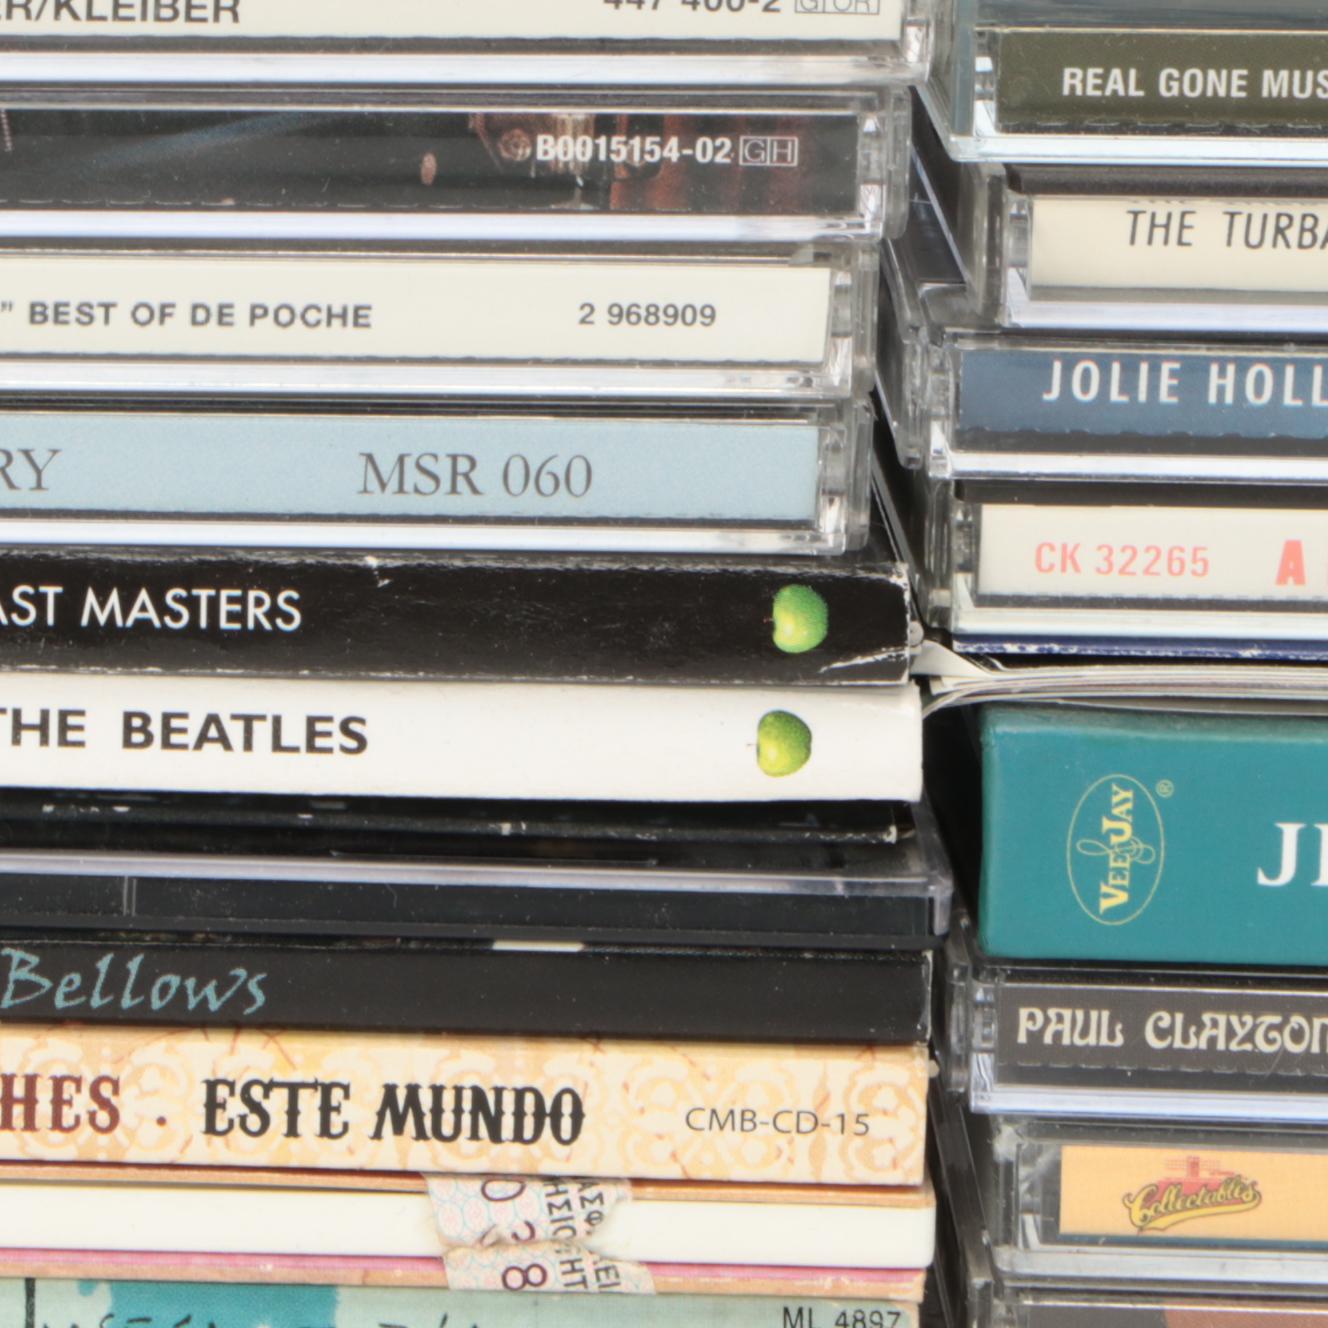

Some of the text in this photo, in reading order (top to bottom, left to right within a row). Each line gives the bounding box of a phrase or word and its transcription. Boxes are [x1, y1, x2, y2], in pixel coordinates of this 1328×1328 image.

[1062, 67, 1145, 97] REAL
[1158, 67, 1249, 98] GONE
[534, 132, 734, 166] B0015154-02
[1126, 209, 1197, 247] THE
[28, 301, 118, 327] BEST
[130, 301, 177, 328] OF
[190, 302, 235, 327] DE
[249, 303, 373, 329] POCHE
[578, 302, 717, 327] 2 968909
[1041, 359, 1328, 408] JOLIE HOLL
[358, 452, 593, 499] MSR 060
[1034, 538, 1308, 586] CK 32265 A
[80, 587, 302, 632] MASTERS
[122, 710, 368, 756] BEATLES
[0, 946, 267, 1015] Bellows
[1017, 1007, 1125, 1048] PAUL
[202, 1078, 351, 1141] ESTE
[369, 1083, 586, 1146] MUNDO
[685, 1100, 870, 1137] CMB-CD-15
